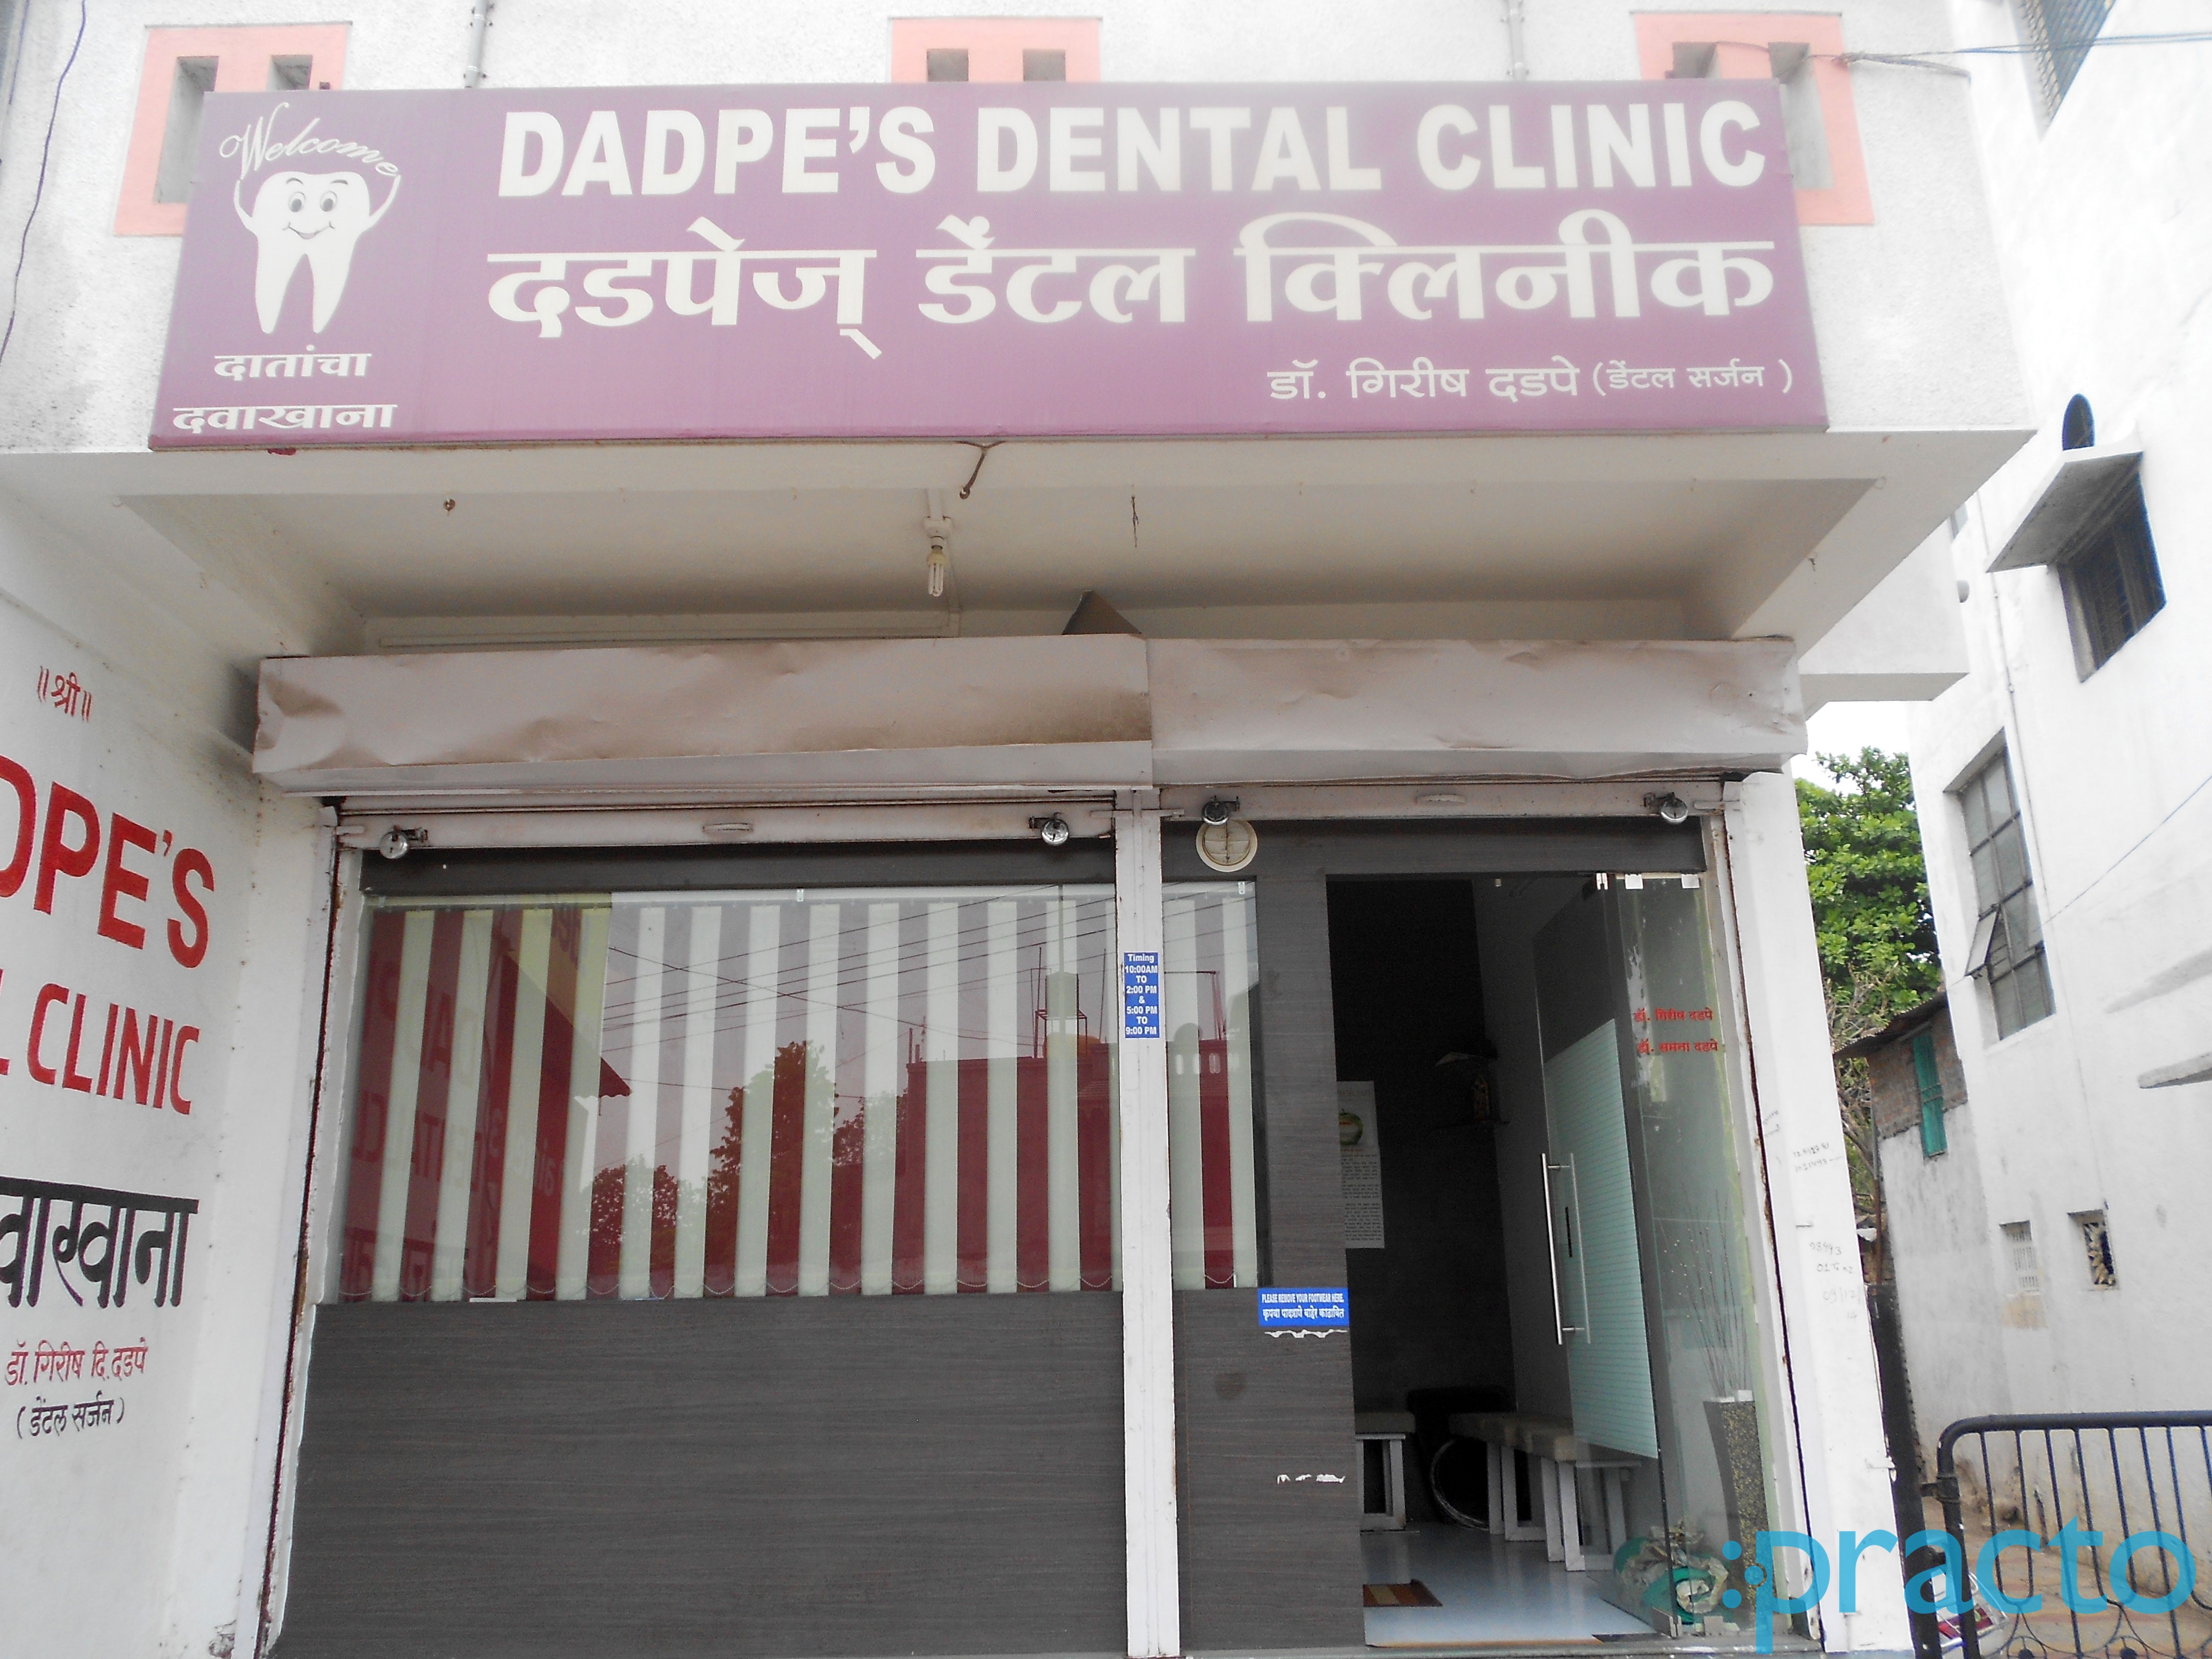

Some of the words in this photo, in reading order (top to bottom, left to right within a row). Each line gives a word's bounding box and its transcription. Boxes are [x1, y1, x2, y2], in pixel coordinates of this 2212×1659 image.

[220, 102, 398, 180] Welcome
[498, 105, 936, 197] DADPE'S
[977, 107, 1381, 192] DENTAL
[1417, 100, 1766, 190] CLINIC
[916, 214, 1196, 324] डेंटल
[214, 344, 372, 381] दातांचा
[1346, 356, 1470, 398] गिरीष
[1485, 355, 1580, 402] दडपे
[173, 404, 398, 434] दवाखाना
[1125, 965, 1158, 973] 10:00AM
[1128, 953, 1155, 963] Timing
[1126, 986, 1143, 994] 2:00
[27, 982, 200, 1115] CLINIC
[1126, 1027, 1143, 1035] 9:00
[0, 1176, 200, 1308] वाखाना
[1262, 1293, 1278, 1303] PLEASE
[1296, 1293, 1308, 1303] YOUR
[33, 1339, 86, 1383] गिरीष
